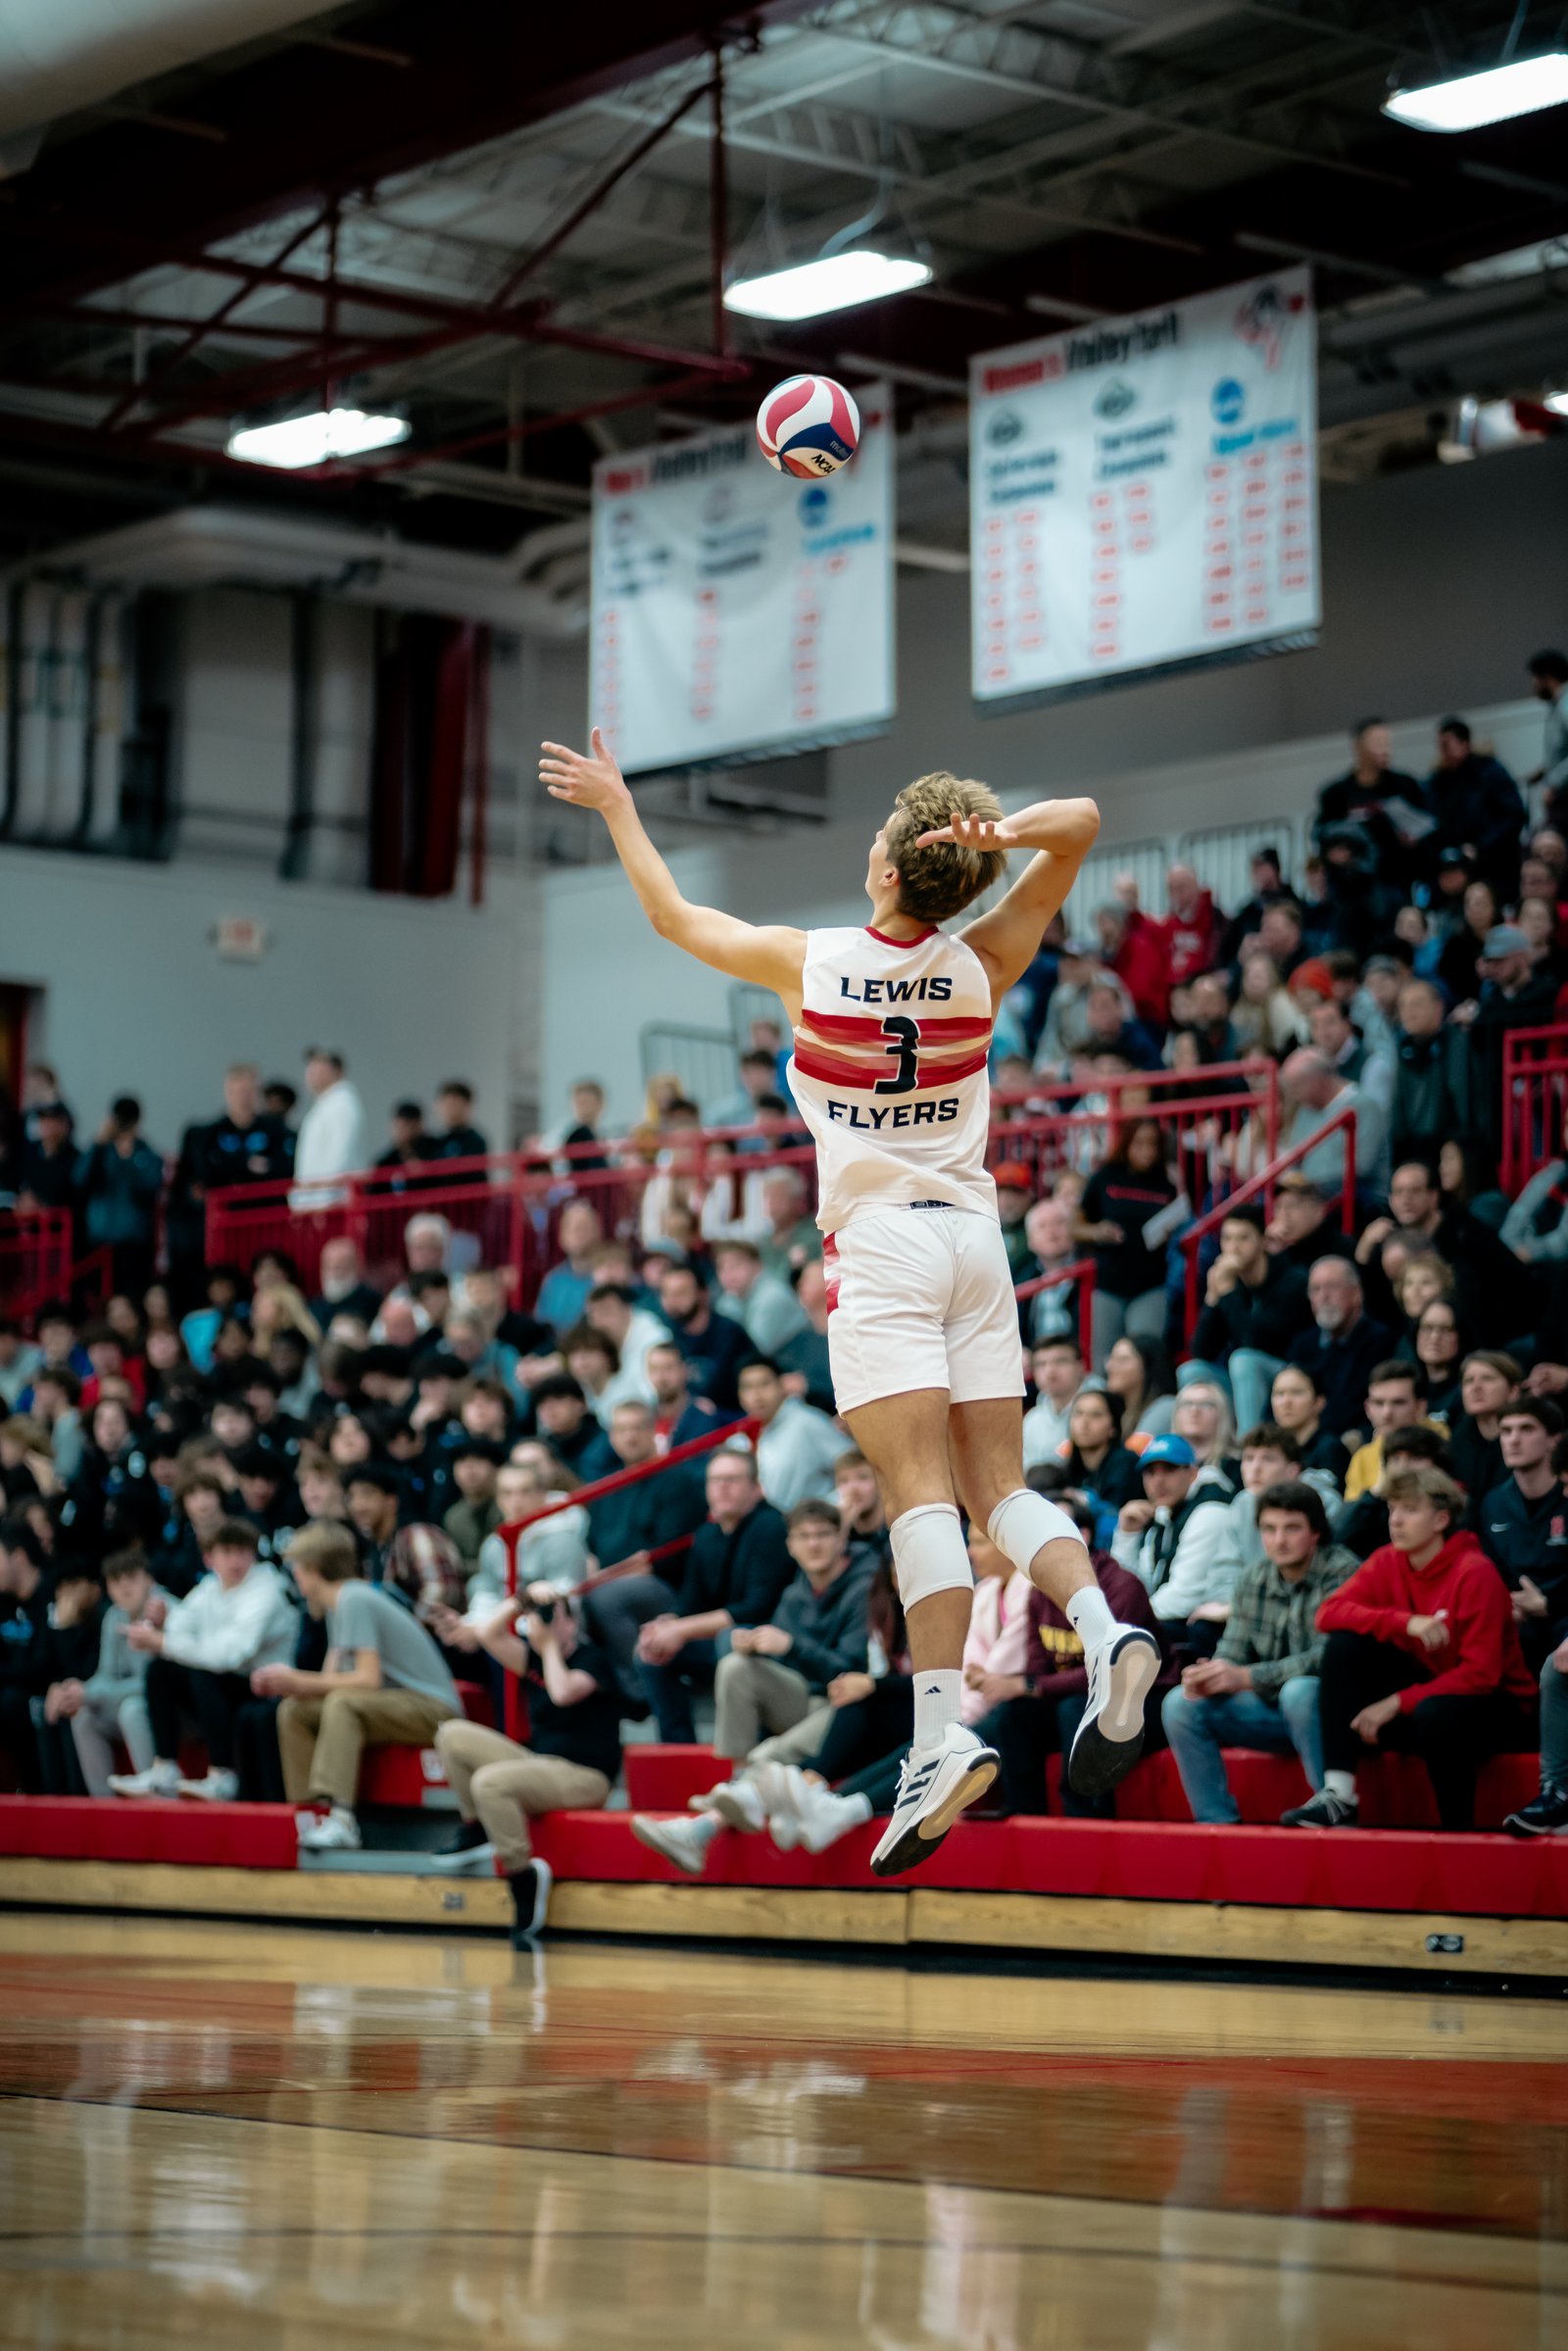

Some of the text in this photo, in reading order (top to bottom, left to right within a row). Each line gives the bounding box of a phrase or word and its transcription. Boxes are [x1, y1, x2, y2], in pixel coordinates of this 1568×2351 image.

[840, 976, 953, 1003] LEWIS
[874, 1015, 920, 1095] 3
[827, 1098, 959, 1129] FLYERS
